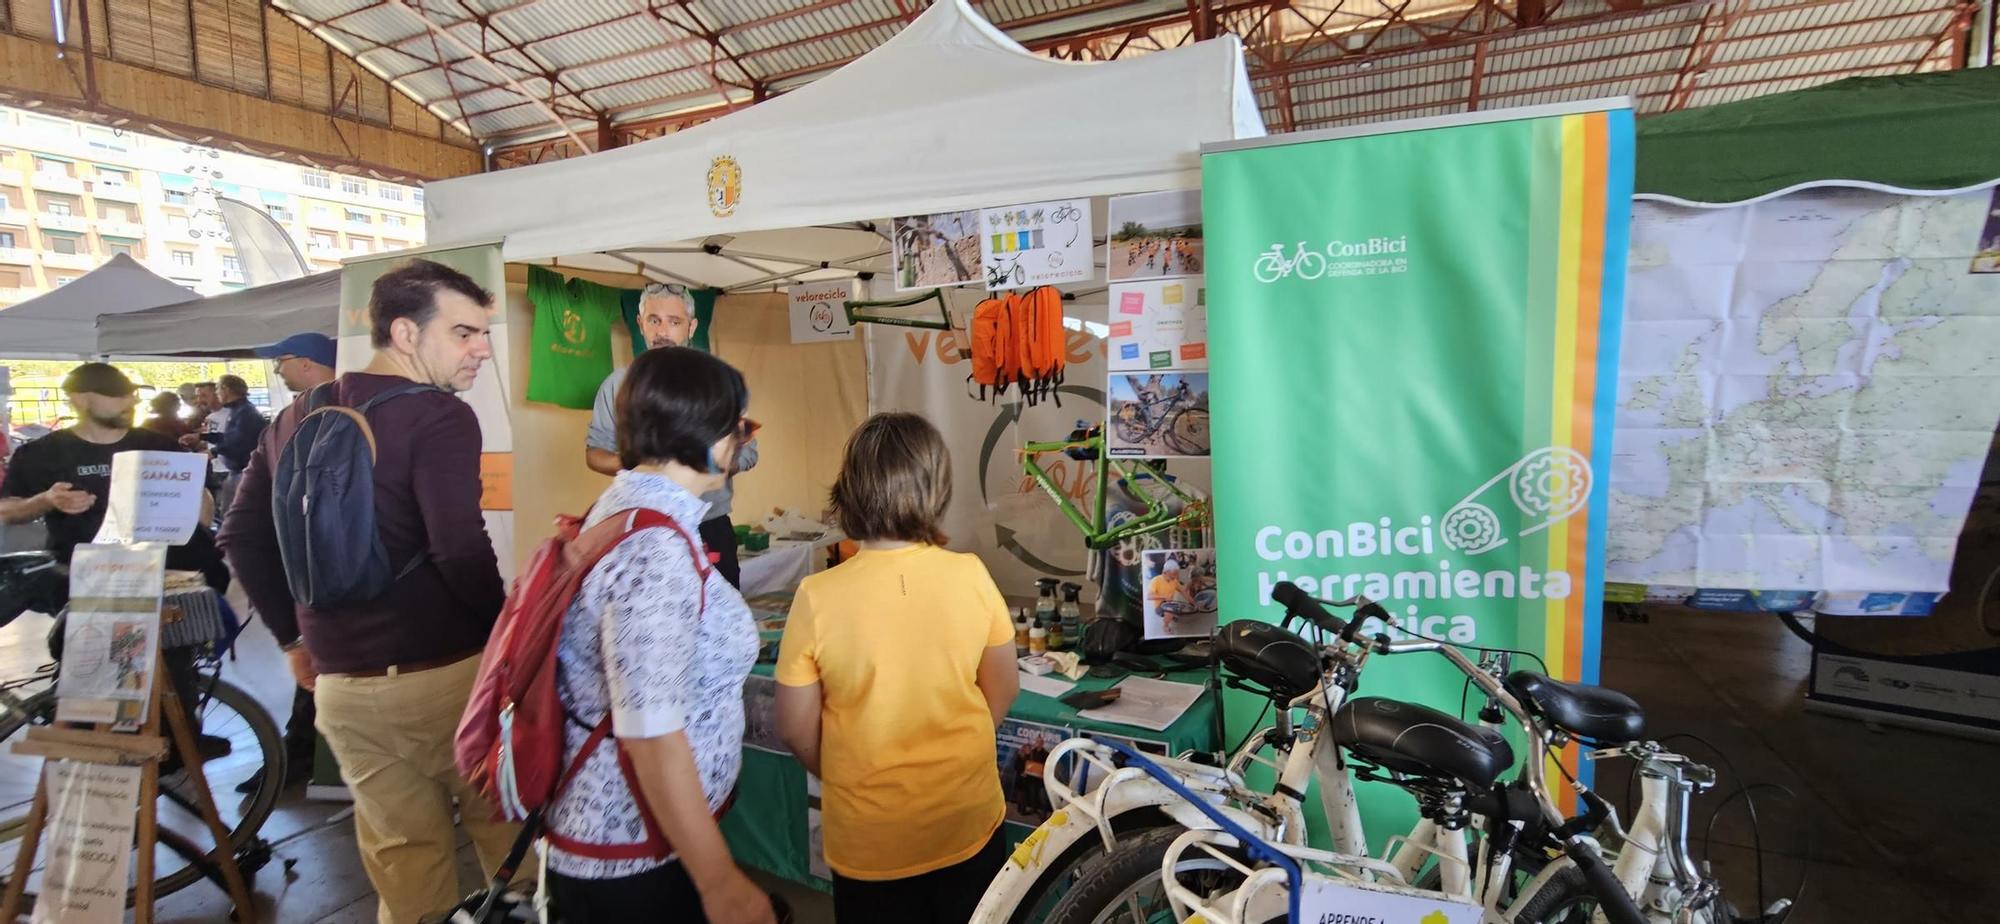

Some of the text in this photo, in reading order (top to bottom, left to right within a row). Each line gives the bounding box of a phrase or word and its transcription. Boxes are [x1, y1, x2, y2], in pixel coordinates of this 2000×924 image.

[1327, 235, 1407, 257] ConBici
[1394, 257, 1408, 265] EN
[1254, 515, 1433, 561] ConBici
[1258, 559, 1572, 606] Herramienta
